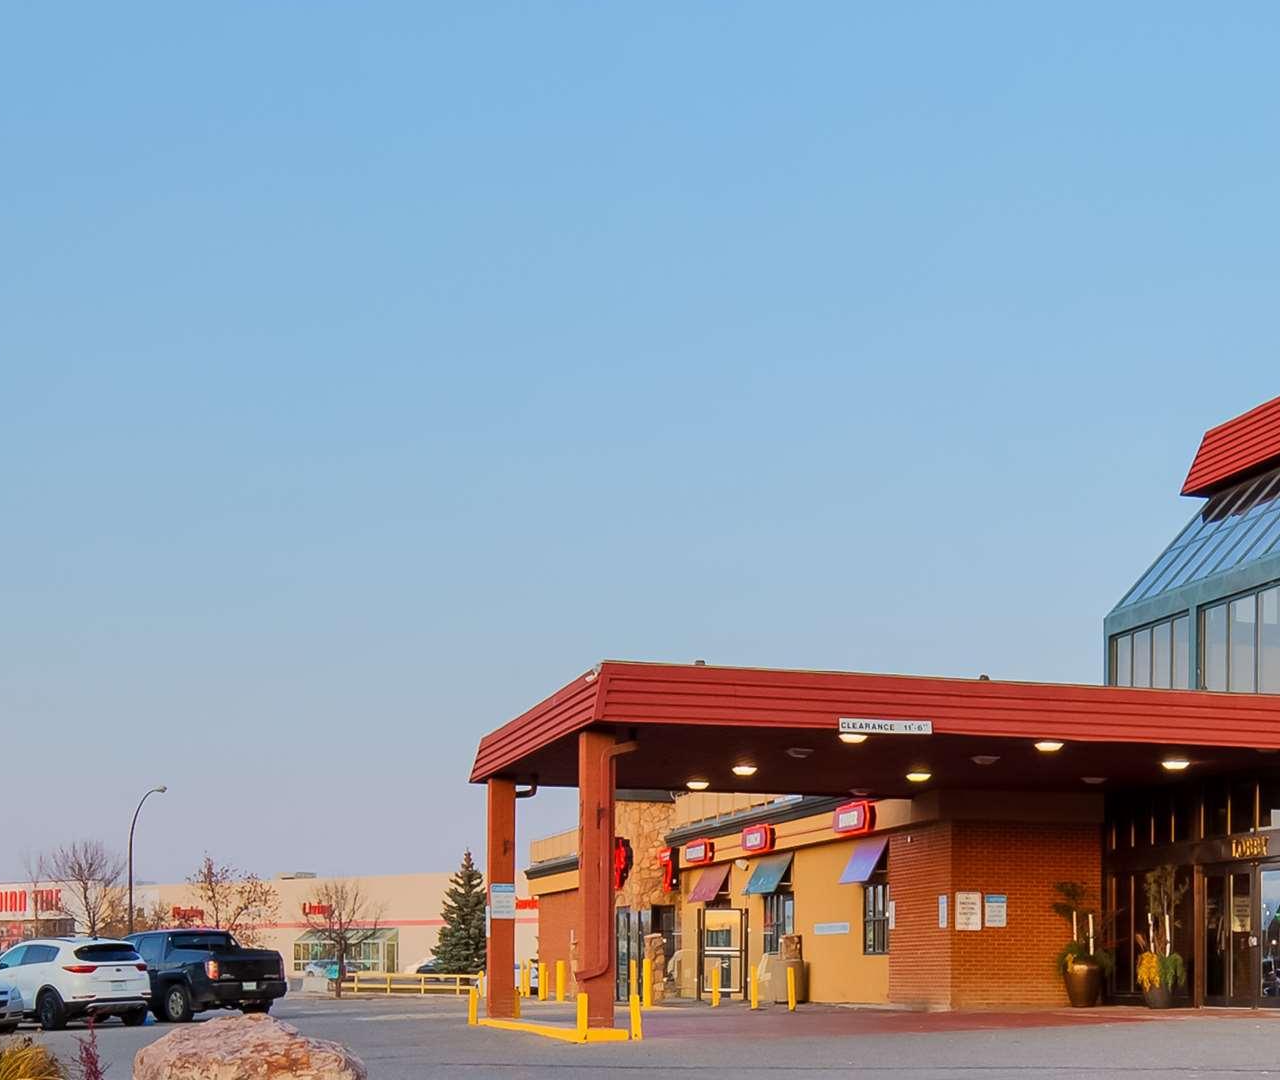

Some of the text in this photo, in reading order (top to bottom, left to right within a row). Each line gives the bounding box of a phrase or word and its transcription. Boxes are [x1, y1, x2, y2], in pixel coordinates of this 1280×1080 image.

[841, 721, 895, 731] CLEARANCE
[1232, 836, 1270, 857] LOBBY
[33, 889, 62, 912] TIRE
